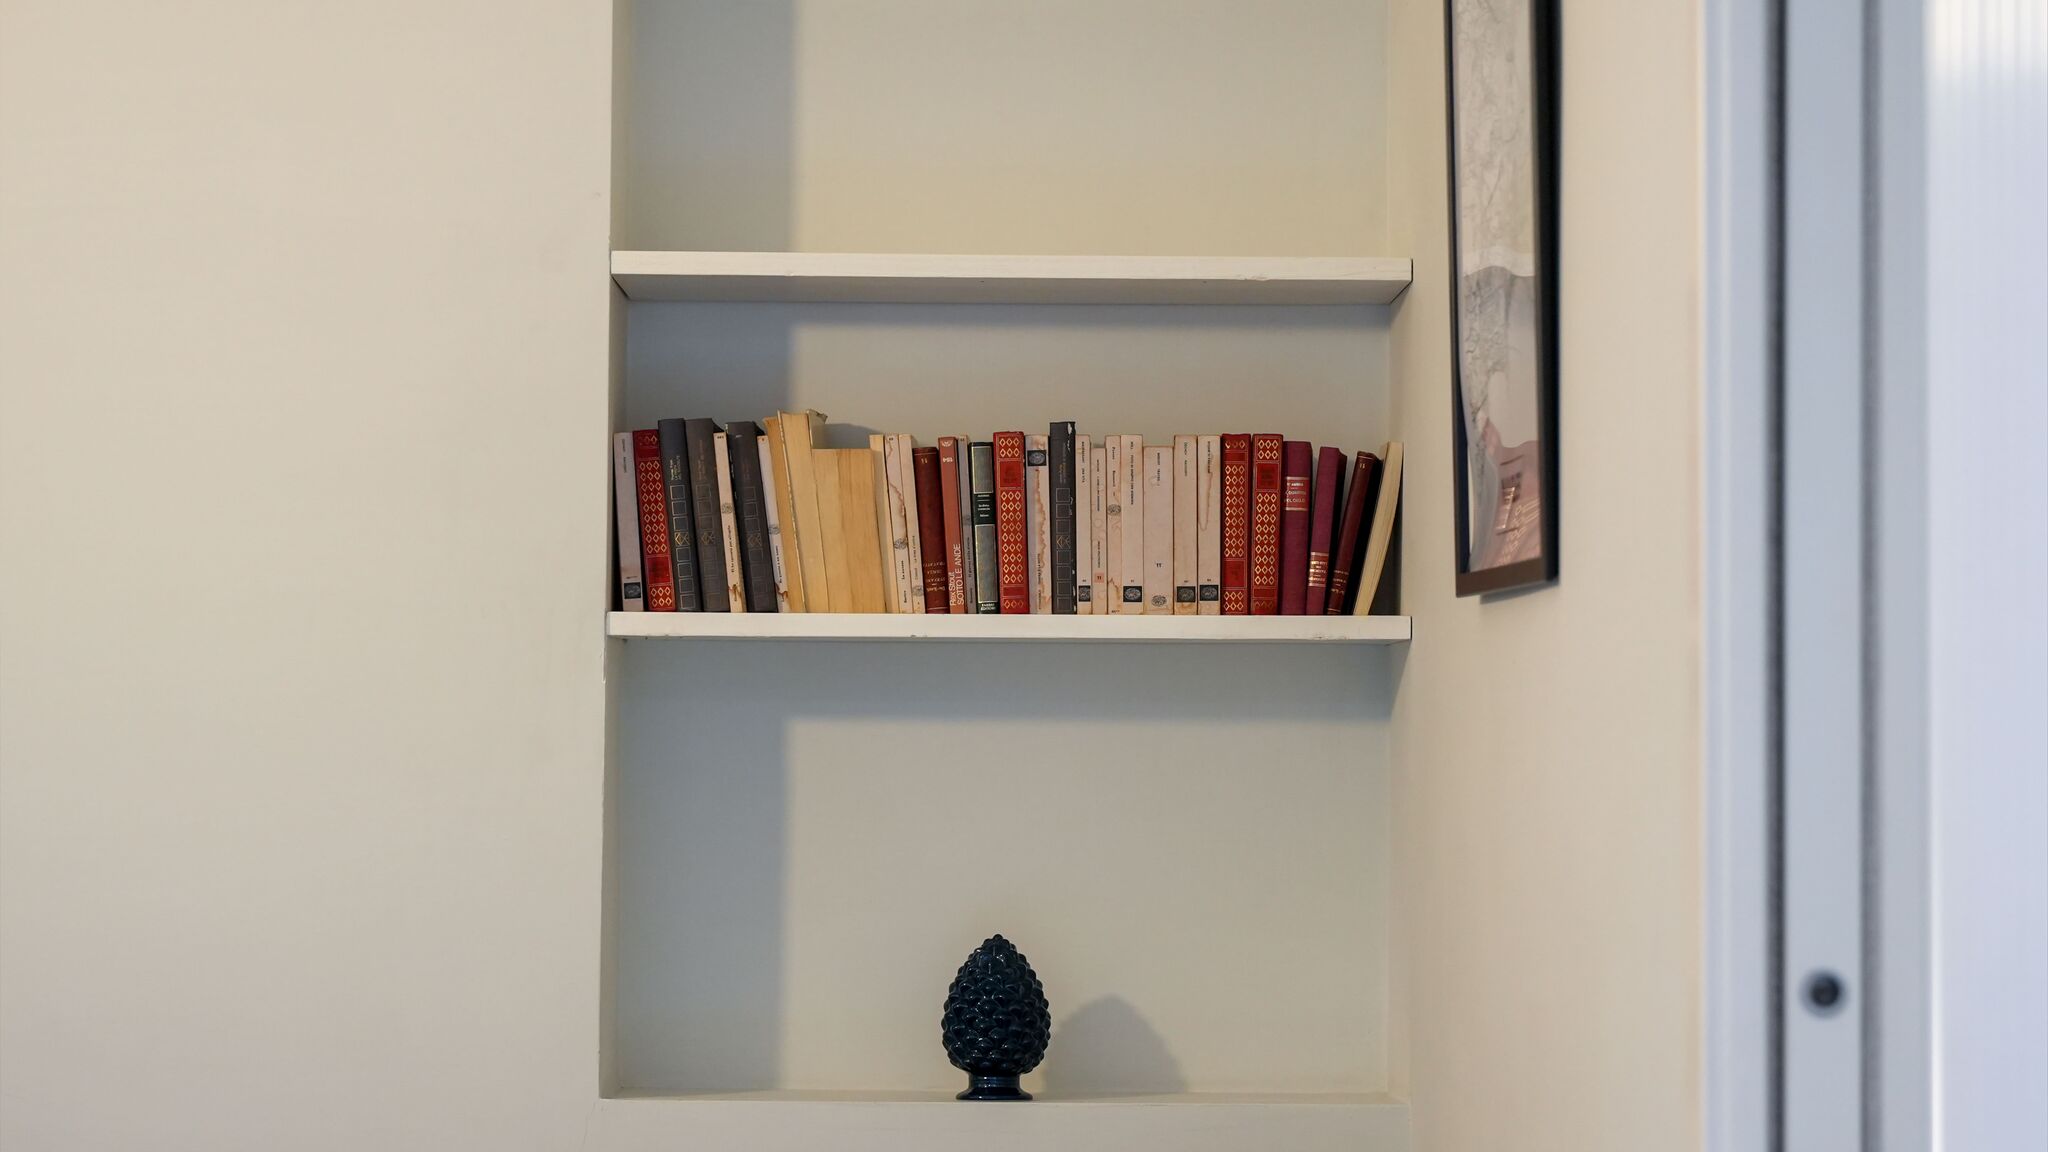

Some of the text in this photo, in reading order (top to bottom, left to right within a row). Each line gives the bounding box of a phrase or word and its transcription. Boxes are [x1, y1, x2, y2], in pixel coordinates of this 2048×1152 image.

[952, 543, 965, 606] SOTTO LE ANDE
[949, 591, 957, 606] Rex
